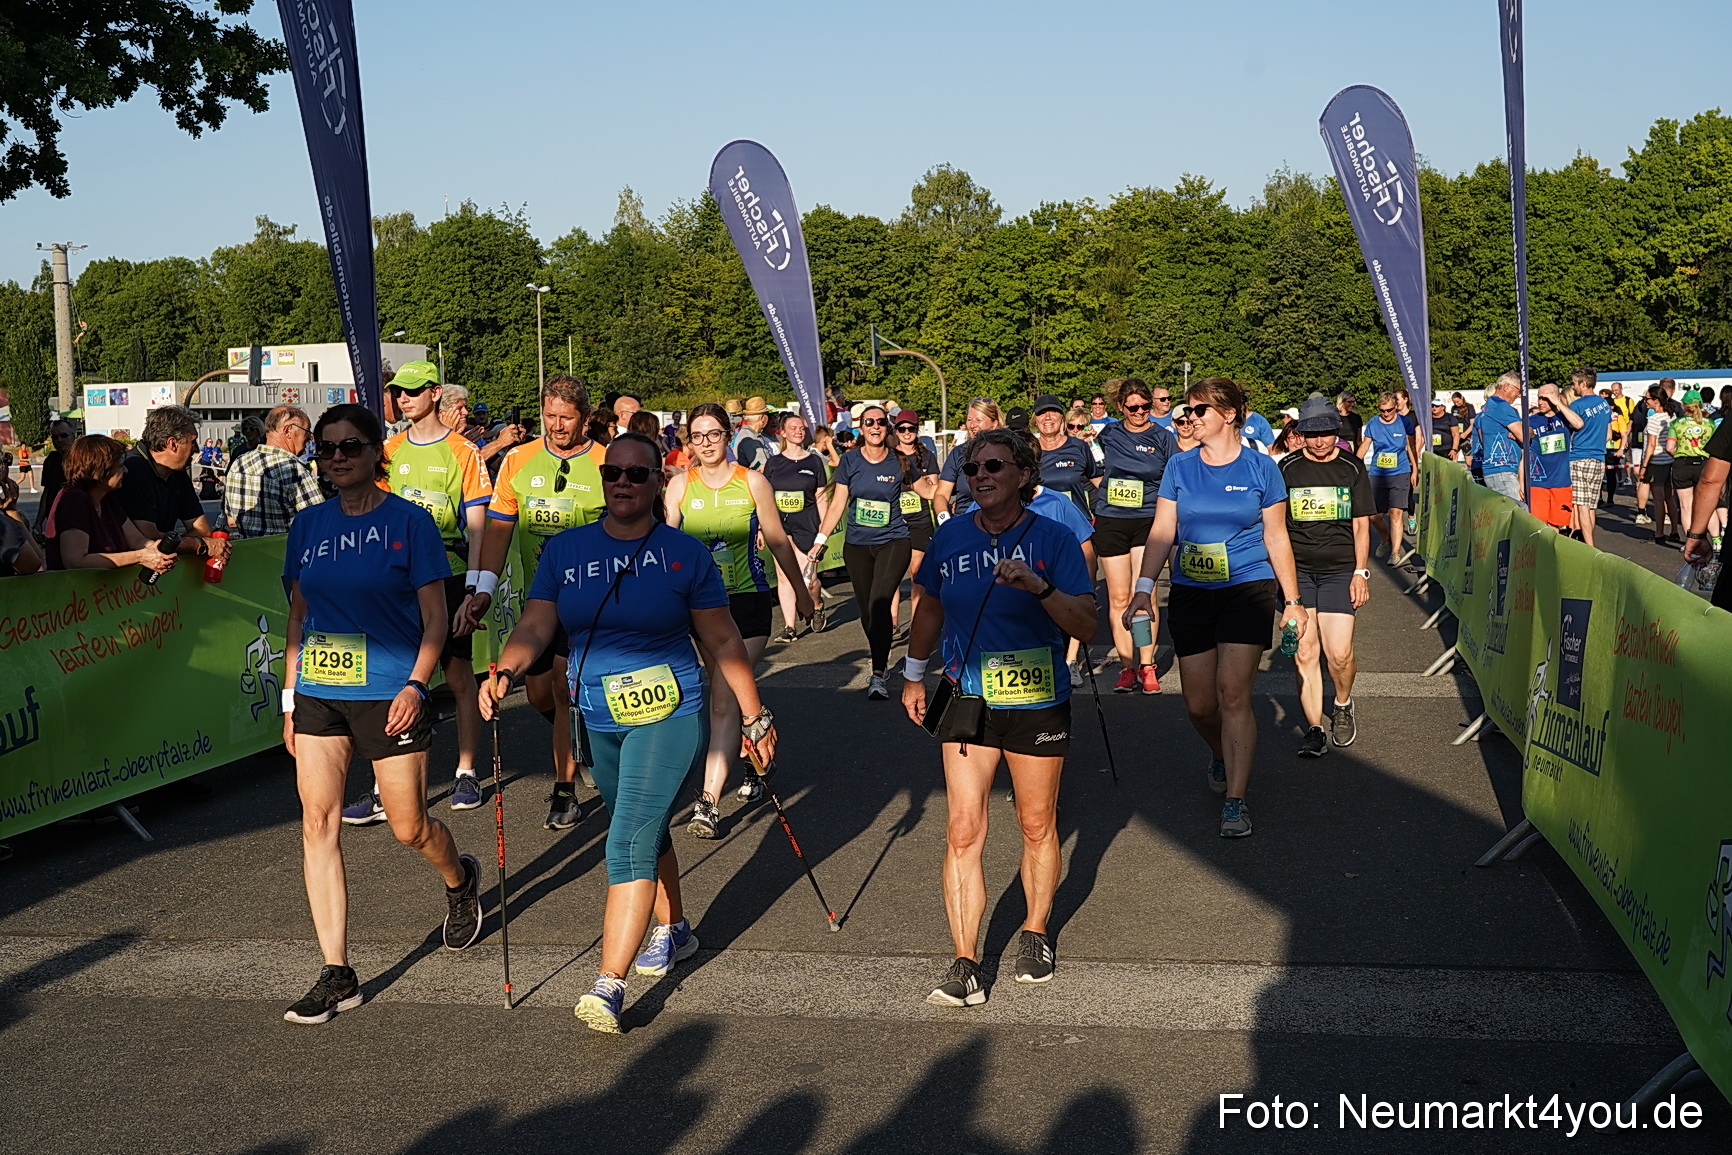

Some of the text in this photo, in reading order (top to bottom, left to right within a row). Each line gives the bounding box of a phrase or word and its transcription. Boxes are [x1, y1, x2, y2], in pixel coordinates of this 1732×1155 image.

[1135, 444, 1148, 453] vhs
[876, 474, 889, 483] vhs
[780, 498, 800, 506] 1669
[1111, 487, 1138, 499] 1426
[859, 508, 885, 520] 1425
[1301, 498, 1326, 511] 262
[535, 510, 560, 524] 636
[1189, 556, 1214, 570] 440
[92, 578, 163, 617] Firmen
[1563, 631, 1582, 652] Fischer
[50, 631, 122, 675] laufen
[310, 648, 354, 670] 1298
[314, 667, 347, 677] Zink Beate
[355, 654, 363, 679] 2022
[995, 666, 1043, 688] 1299
[986, 672, 994, 698] WALK
[993, 686, 1046, 696] Fürbach Renate
[618, 684, 667, 710] 1300
[666, 683, 677, 709] 2022
[0, 685, 41, 748] uf
[610, 696, 622, 720] WALK
[620, 708, 645, 717] Kröppel
[645, 702, 671, 714] Carmen
[0, 729, 213, 823] ww.firmenlauf-oberpfalz.de
[1531, 753, 1564, 783] neumarkt
